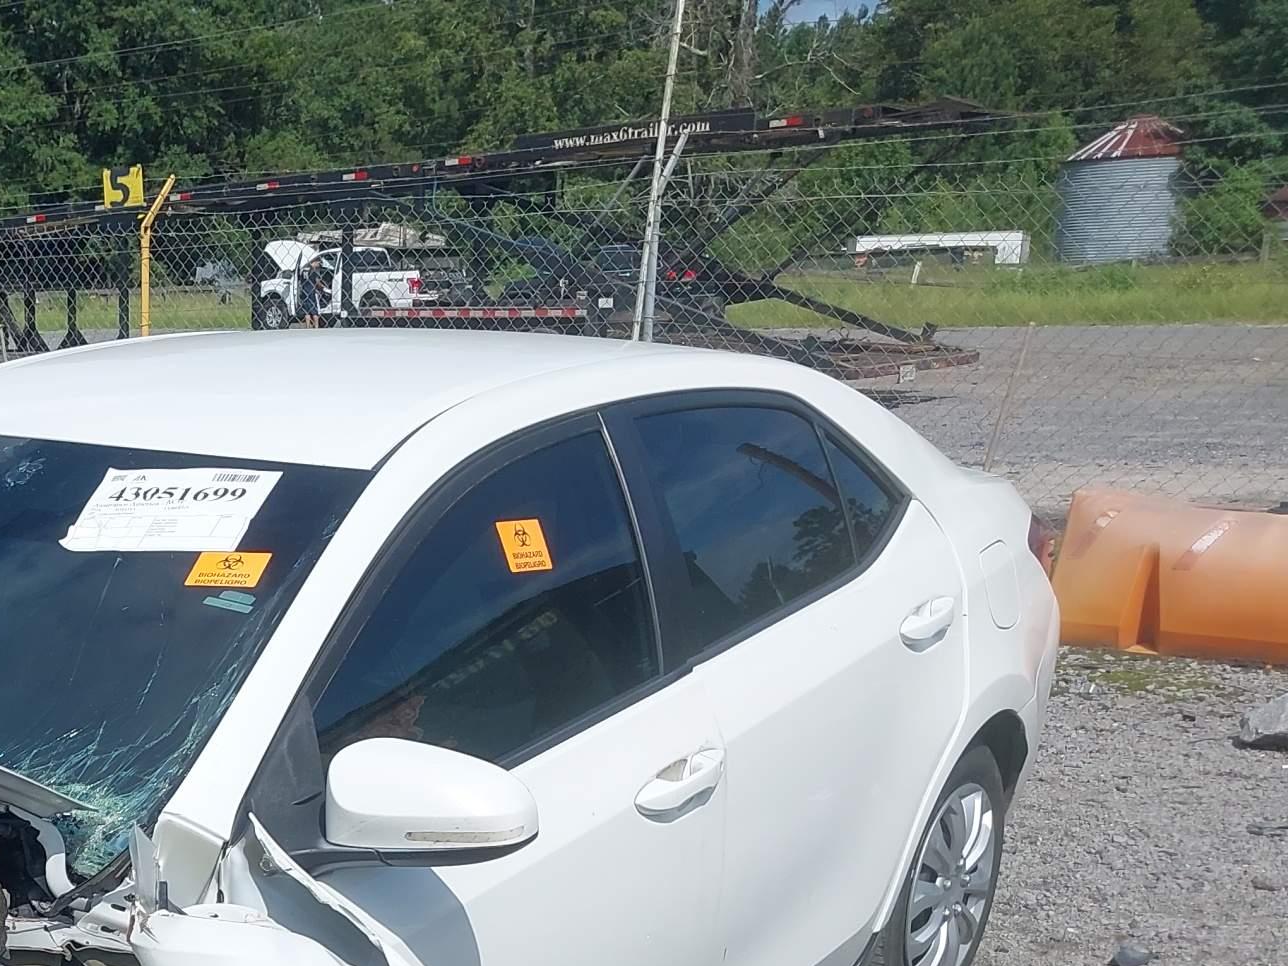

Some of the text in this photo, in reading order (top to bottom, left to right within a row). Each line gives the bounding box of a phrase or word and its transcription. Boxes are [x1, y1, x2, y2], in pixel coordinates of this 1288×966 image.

[552, 121, 710, 149] www.max6trailr.com
[111, 167, 130, 206] 5
[109, 487, 247, 502] 43051699
[512, 551, 543, 559] BIOHAZARD
[515, 560, 546, 569] BIOPELIGRO
